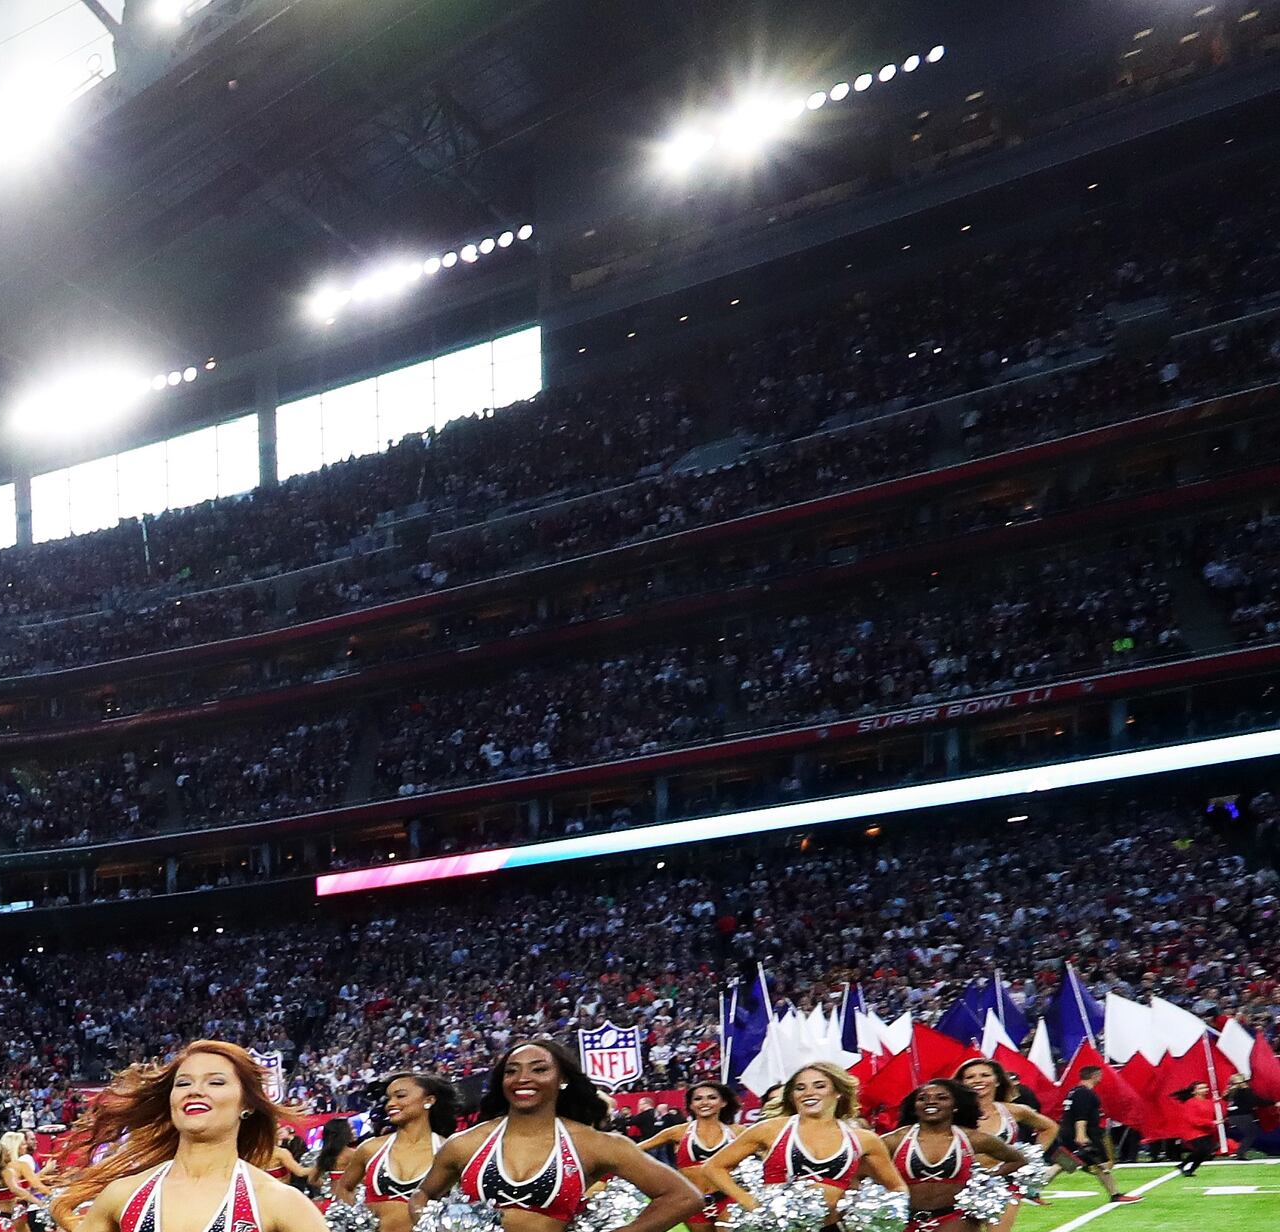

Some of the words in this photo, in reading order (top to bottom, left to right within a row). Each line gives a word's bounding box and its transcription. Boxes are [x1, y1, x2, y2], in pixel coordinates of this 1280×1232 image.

[856, 708, 939, 734] SUPER
[946, 697, 1018, 719] BOWL
[1027, 689, 1053, 704] LI
[588, 1052, 635, 1080] NFL
